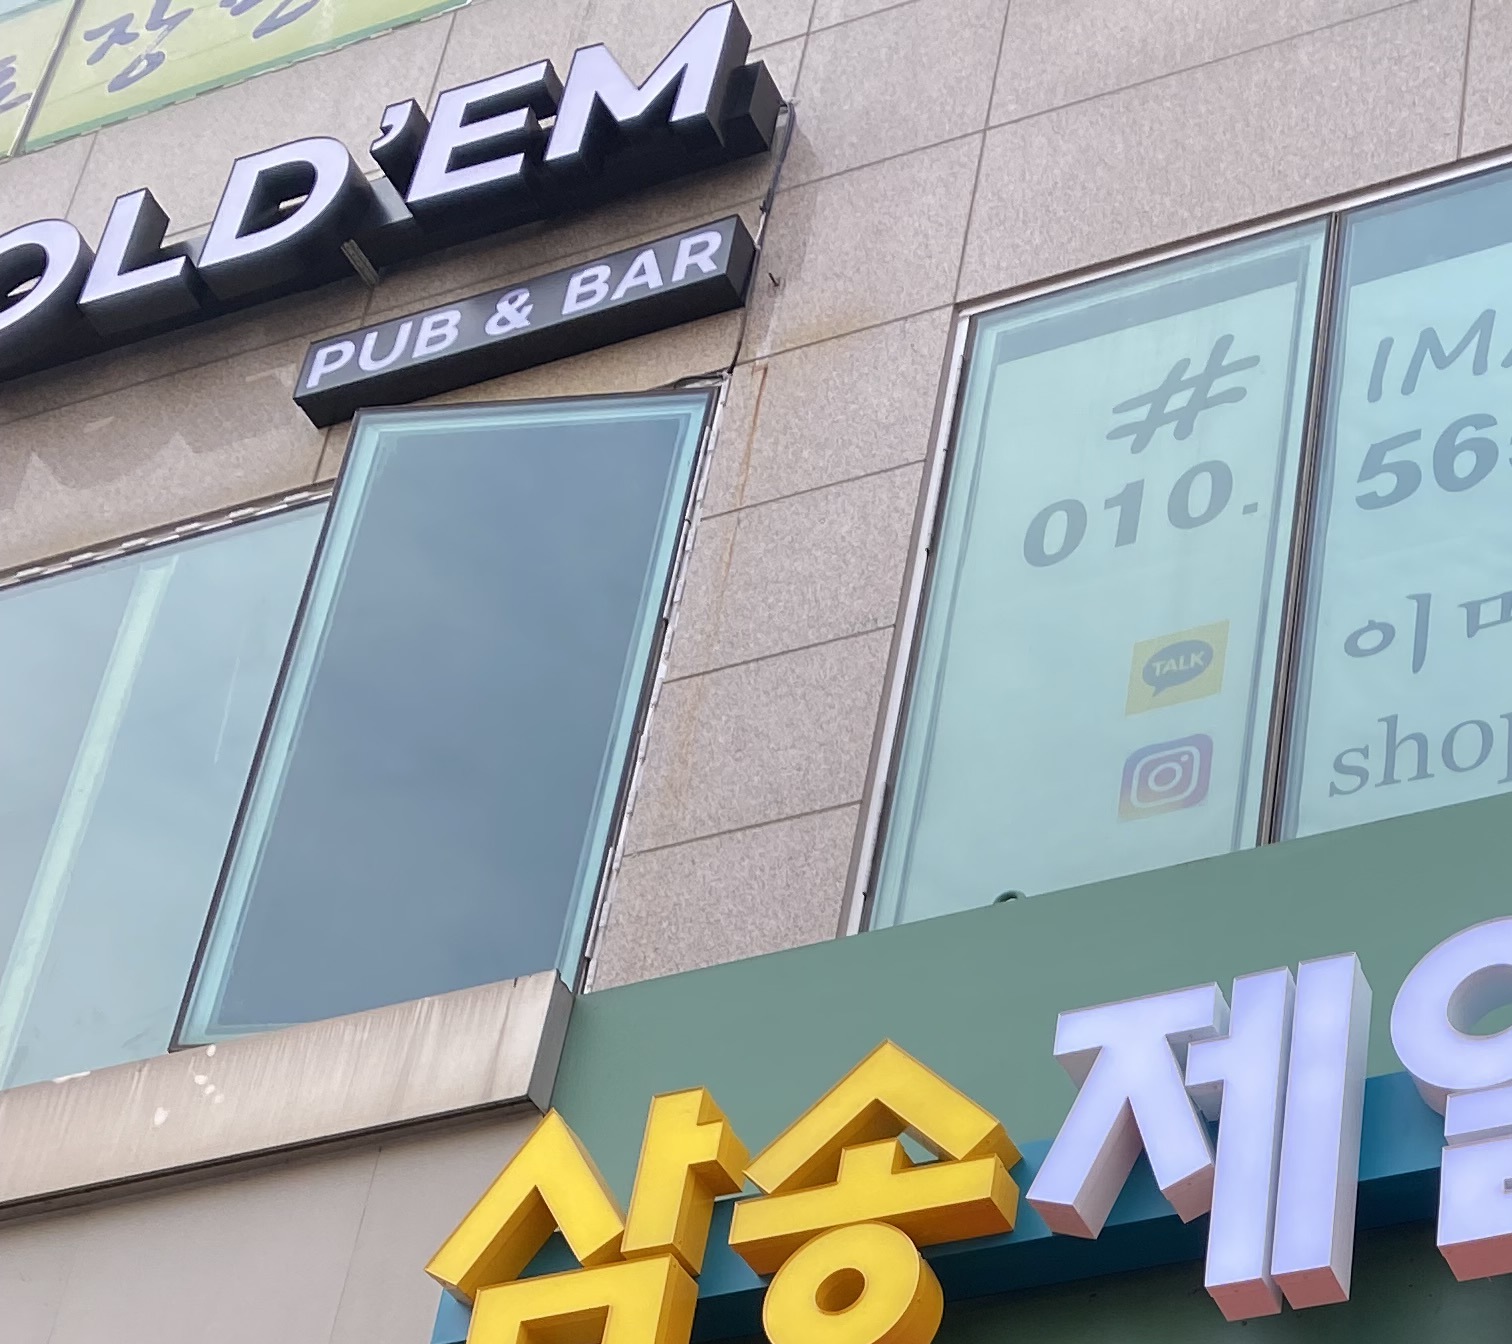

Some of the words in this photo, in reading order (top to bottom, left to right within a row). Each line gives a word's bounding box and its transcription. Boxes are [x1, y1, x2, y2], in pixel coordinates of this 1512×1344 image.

[306, 309, 460, 390] PUB
[485, 289, 534, 337] &
[562, 228, 724, 317] BAR
[1152, 651, 1206, 677] TALK
